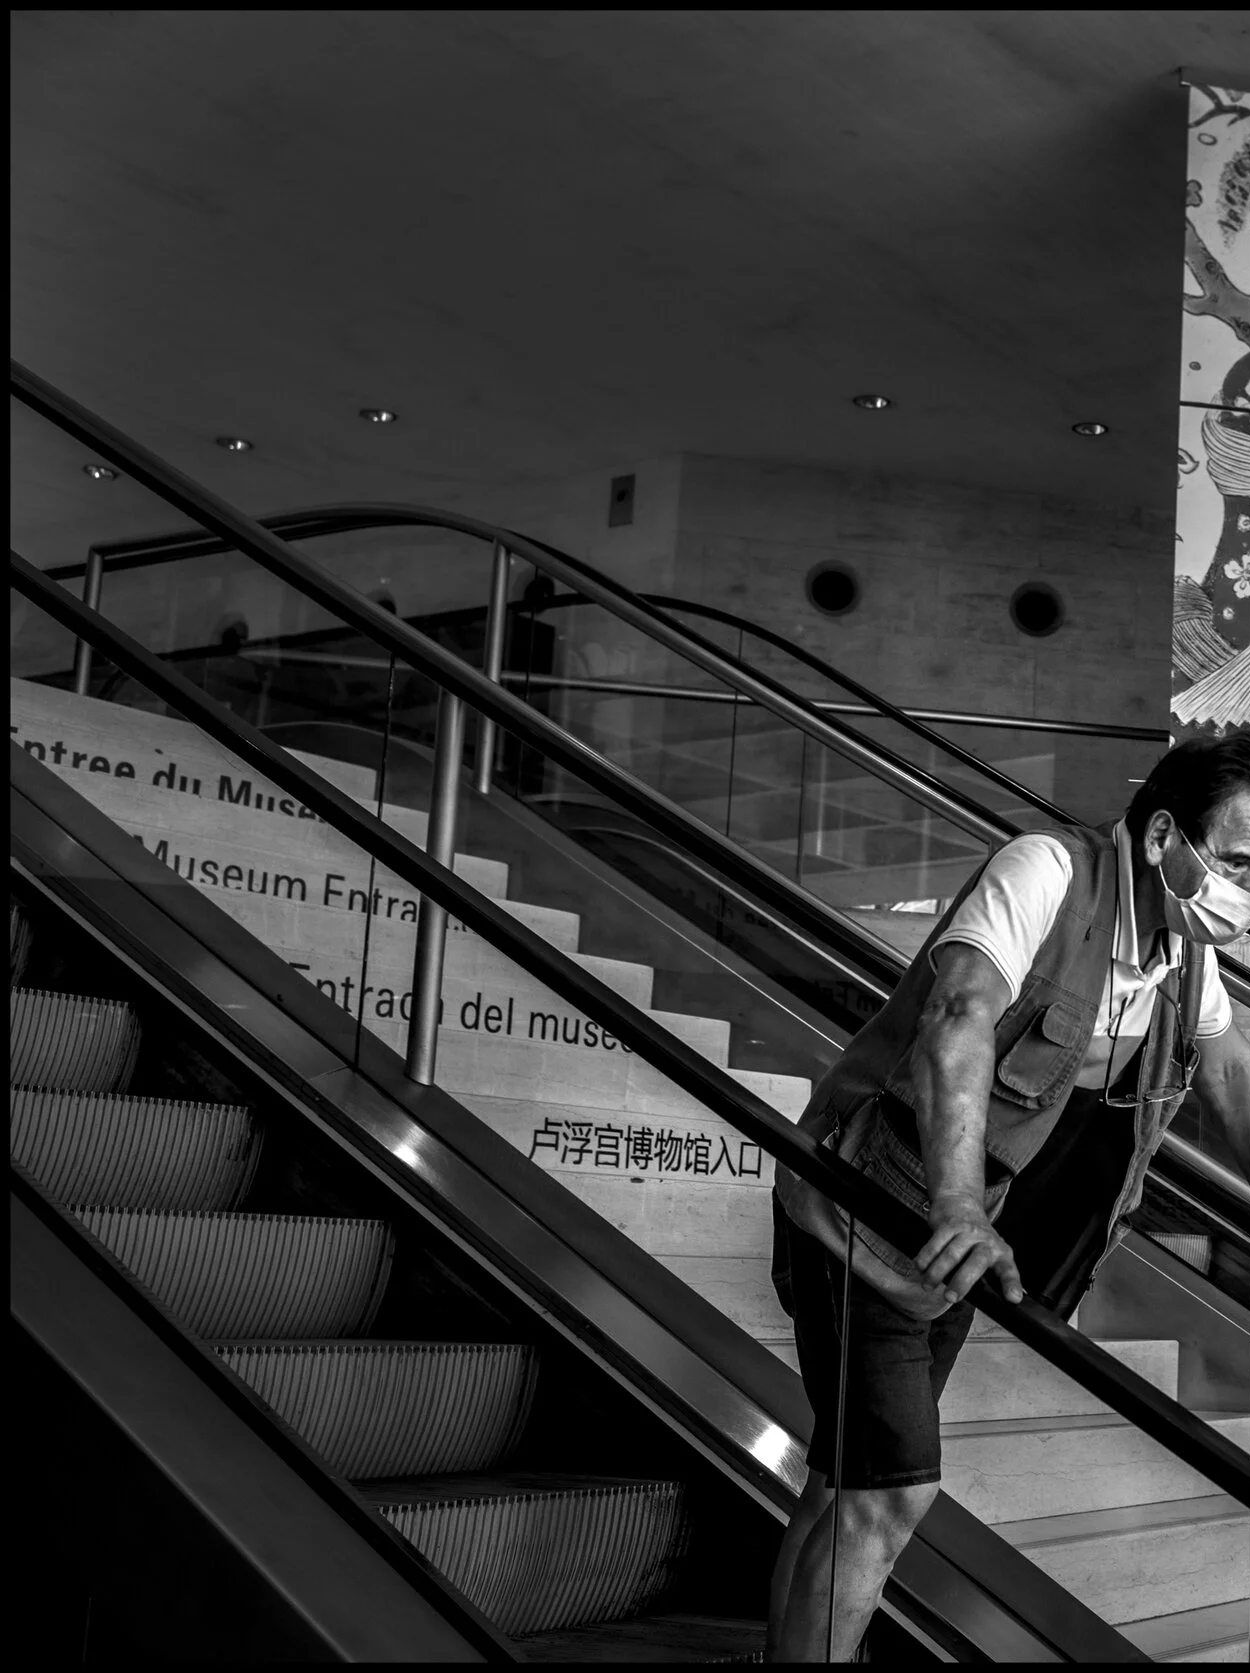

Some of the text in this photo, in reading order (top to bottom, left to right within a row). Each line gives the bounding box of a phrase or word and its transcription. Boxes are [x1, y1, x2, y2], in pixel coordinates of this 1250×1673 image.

[11, 726, 327, 824] ntree du Muse
[323, 874, 478, 934] Entra
[460, 992, 514, 1036] del
[528, 1117, 763, 1179] 卢浮宫博物馆入口
